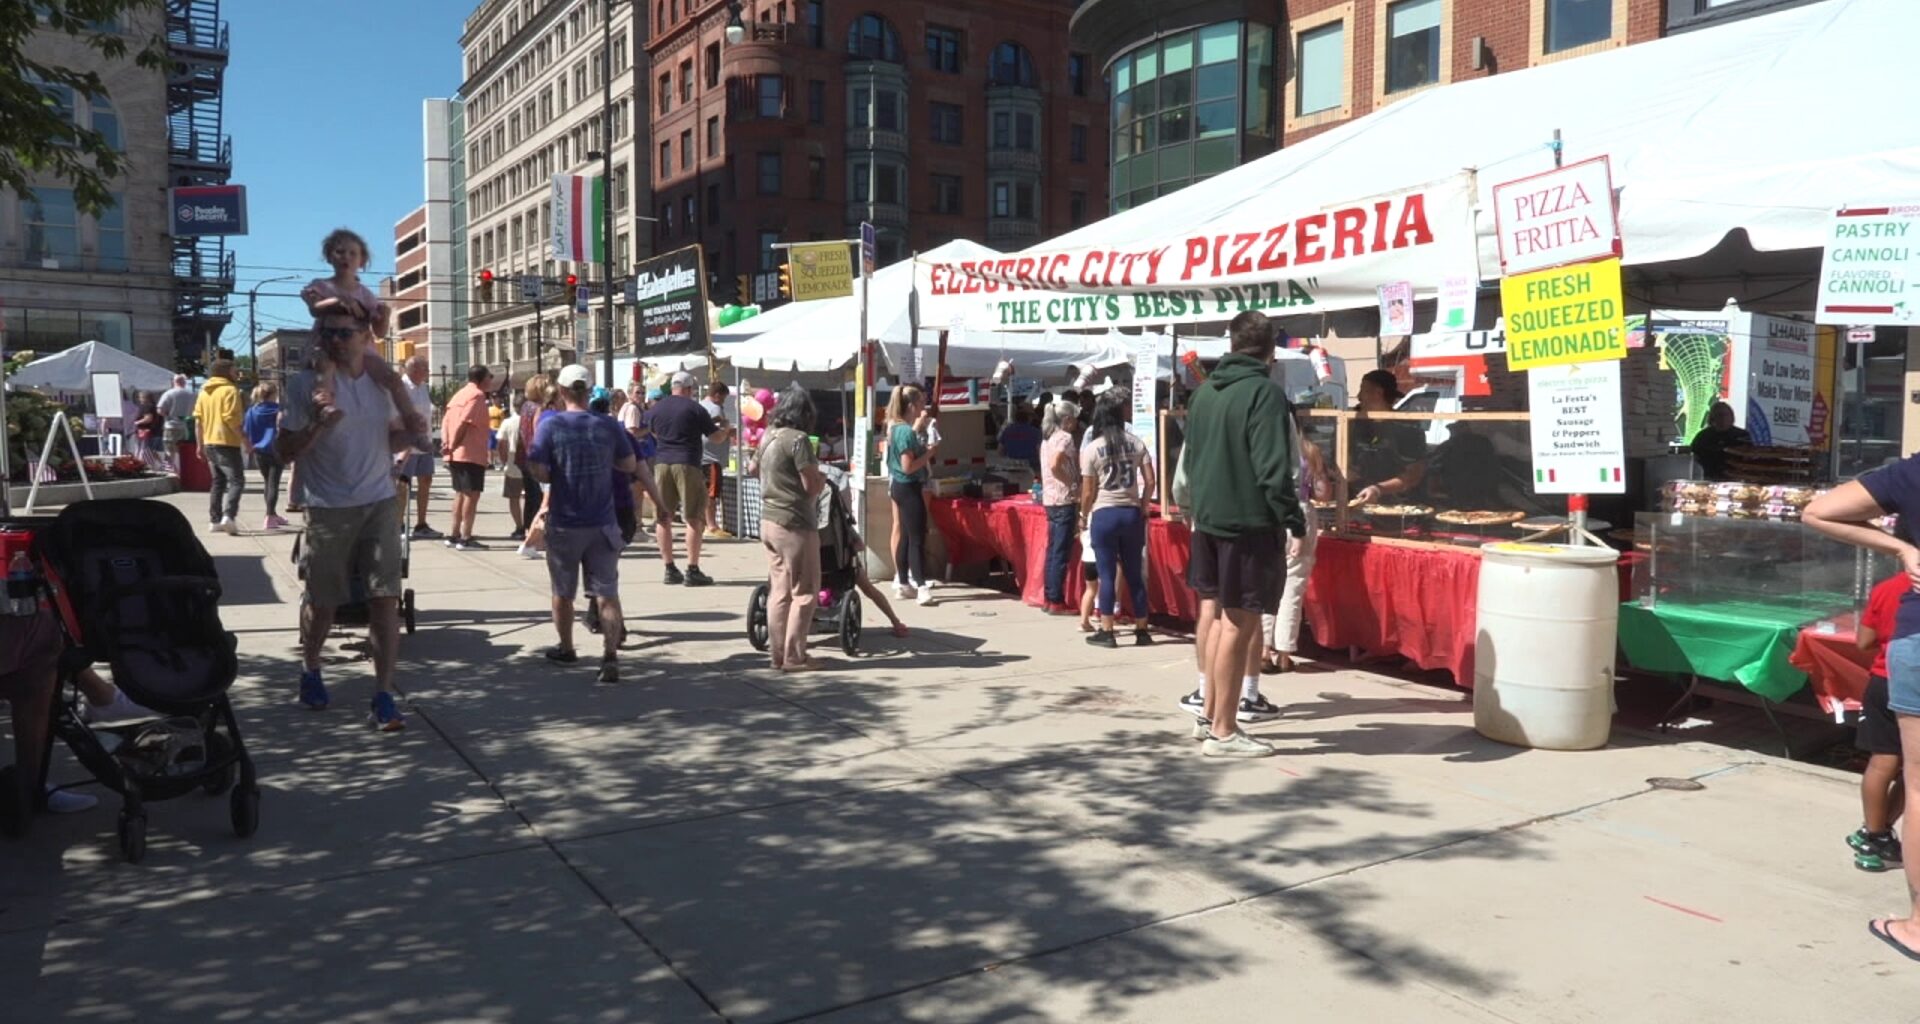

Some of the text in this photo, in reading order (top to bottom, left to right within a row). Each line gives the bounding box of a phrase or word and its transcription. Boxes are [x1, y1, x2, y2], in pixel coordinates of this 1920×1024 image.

[1514, 182, 1592, 222] PIZZA
[1513, 216, 1601, 256] FRITTA
[1835, 222, 1910, 238] PASTRY
[931, 193, 1434, 295] ELECTRIC CITY PIZZERIA
[1832, 247, 1909, 262] CANNOLI
[1831, 270, 1891, 279] FLAVORED
[797, 280, 849, 294] LEMONADE
[1526, 272, 1590, 302] FRESH
[1827, 280, 1904, 294] CANNOLI
[1047, 294, 1120, 321] CITY'S
[1132, 288, 1203, 318] BEST
[1214, 276, 1320, 313] PIZZA"
[1510, 298, 1615, 334] SQUEEZED
[1510, 327, 1620, 362] LEMONADE
[1763, 359, 1810, 381] Our Low Decks
[1552, 393, 1597, 404] La Festa's
[1758, 381, 1811, 403] Make Your Move
[1562, 406, 1587, 415] BEST
[1556, 418, 1594, 427] Sausage
[1552, 429, 1600, 438] & Peppers
[1553, 440, 1601, 449] Sandwich
[1104, 460, 1135, 491] 25
